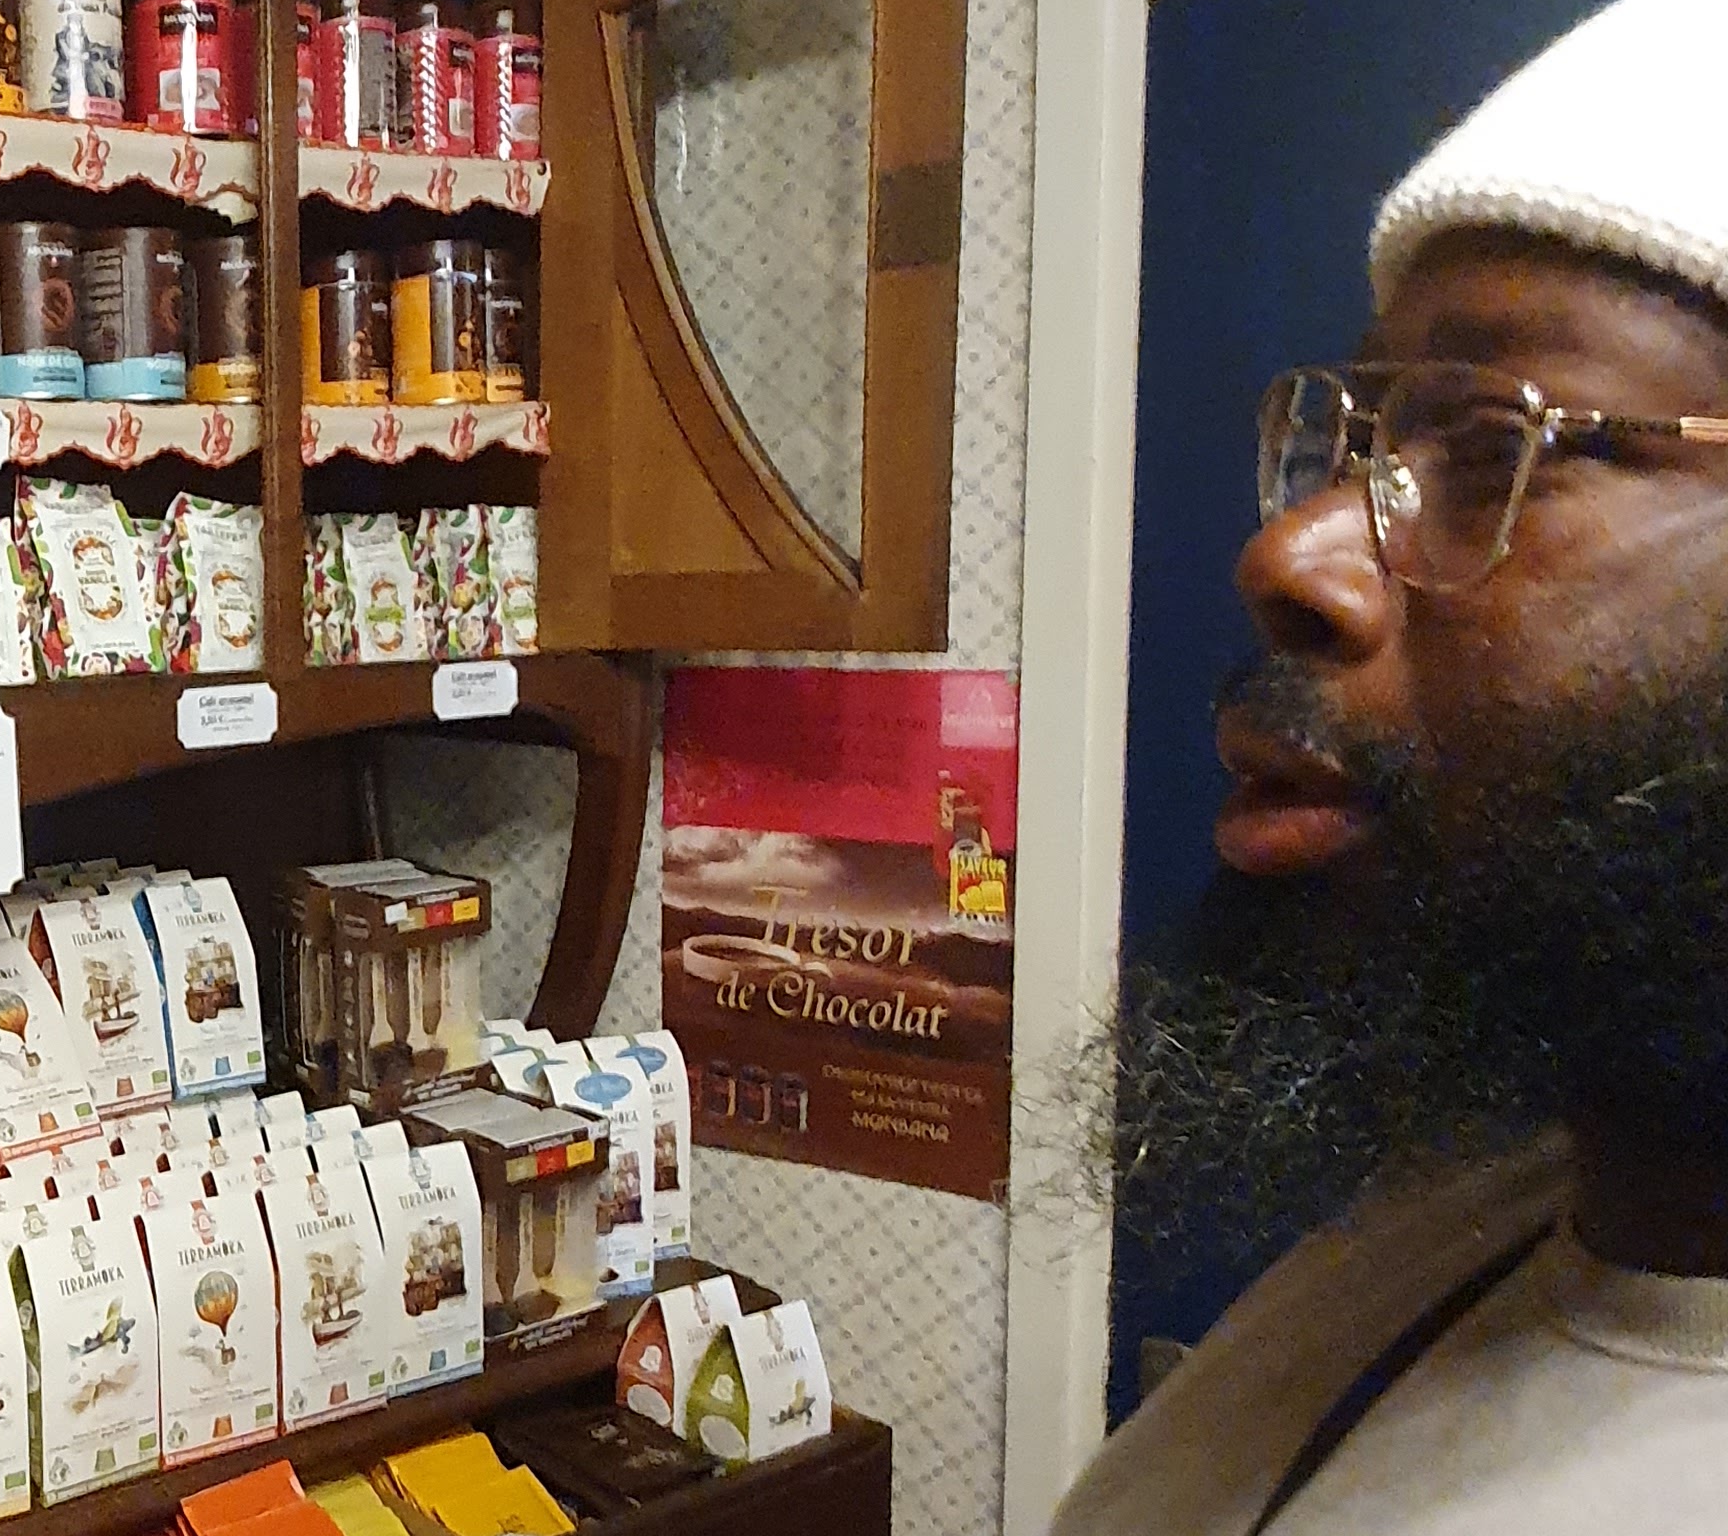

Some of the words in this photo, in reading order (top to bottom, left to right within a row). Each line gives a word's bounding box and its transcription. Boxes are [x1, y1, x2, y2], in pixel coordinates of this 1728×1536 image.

[715, 970, 757, 1011] de
[766, 969, 950, 1041] Chocolat
[851, 1109, 951, 1144] MONBANA
[177, 1239, 246, 1267] TERRAMOKA
[58, 1266, 125, 1296] TERRAMOKA
